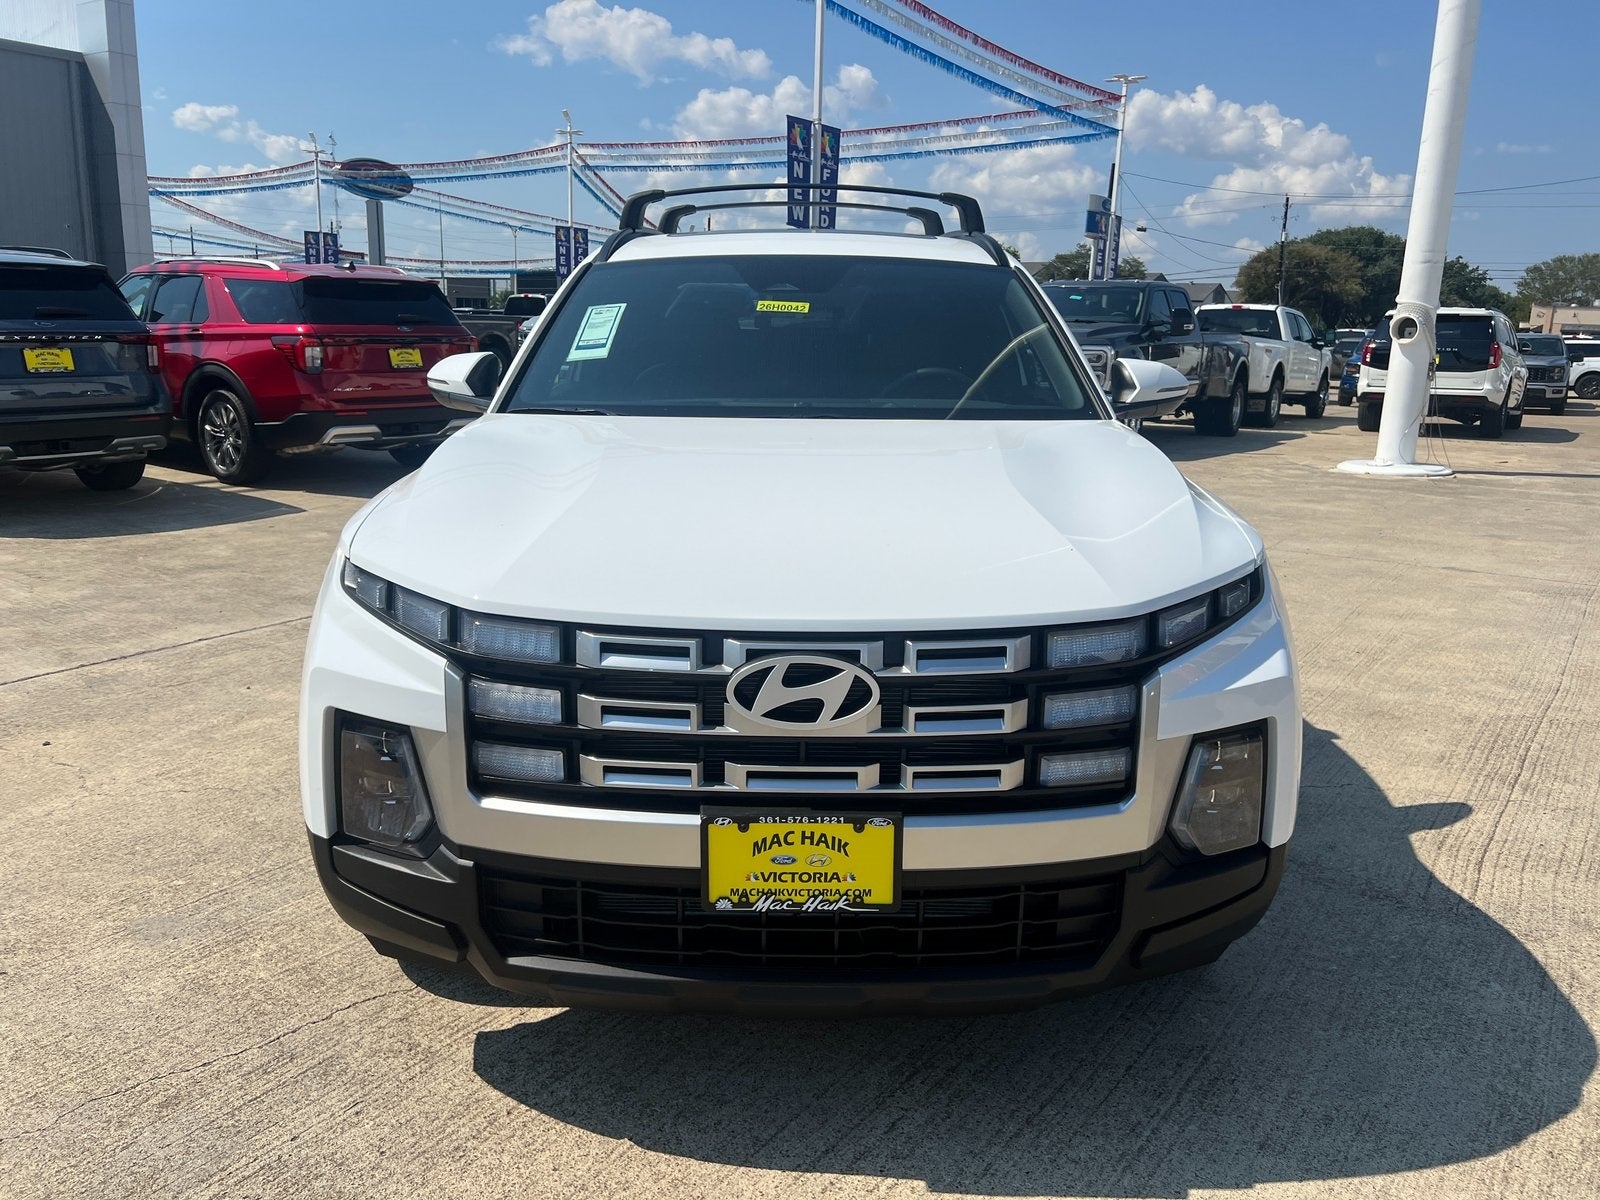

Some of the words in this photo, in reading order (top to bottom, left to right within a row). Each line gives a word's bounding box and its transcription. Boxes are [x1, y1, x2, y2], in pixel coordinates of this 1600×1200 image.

[792, 161, 804, 221] NEW
[820, 169, 831, 227] FORD
[559, 247, 567, 275] NEW
[759, 303, 806, 312] 26H0042
[759, 816, 844, 824] 361-576-1221
[752, 830, 795, 857] MAC
[800, 830, 850, 857] HAIK
[772, 855, 795, 865] Ford
[759, 872, 842, 883] VICTORIA
[730, 888, 872, 898] MACHAIKVICTORIA.COM
[755, 894, 792, 912] Mac
[801, 895, 853, 912] Haik
